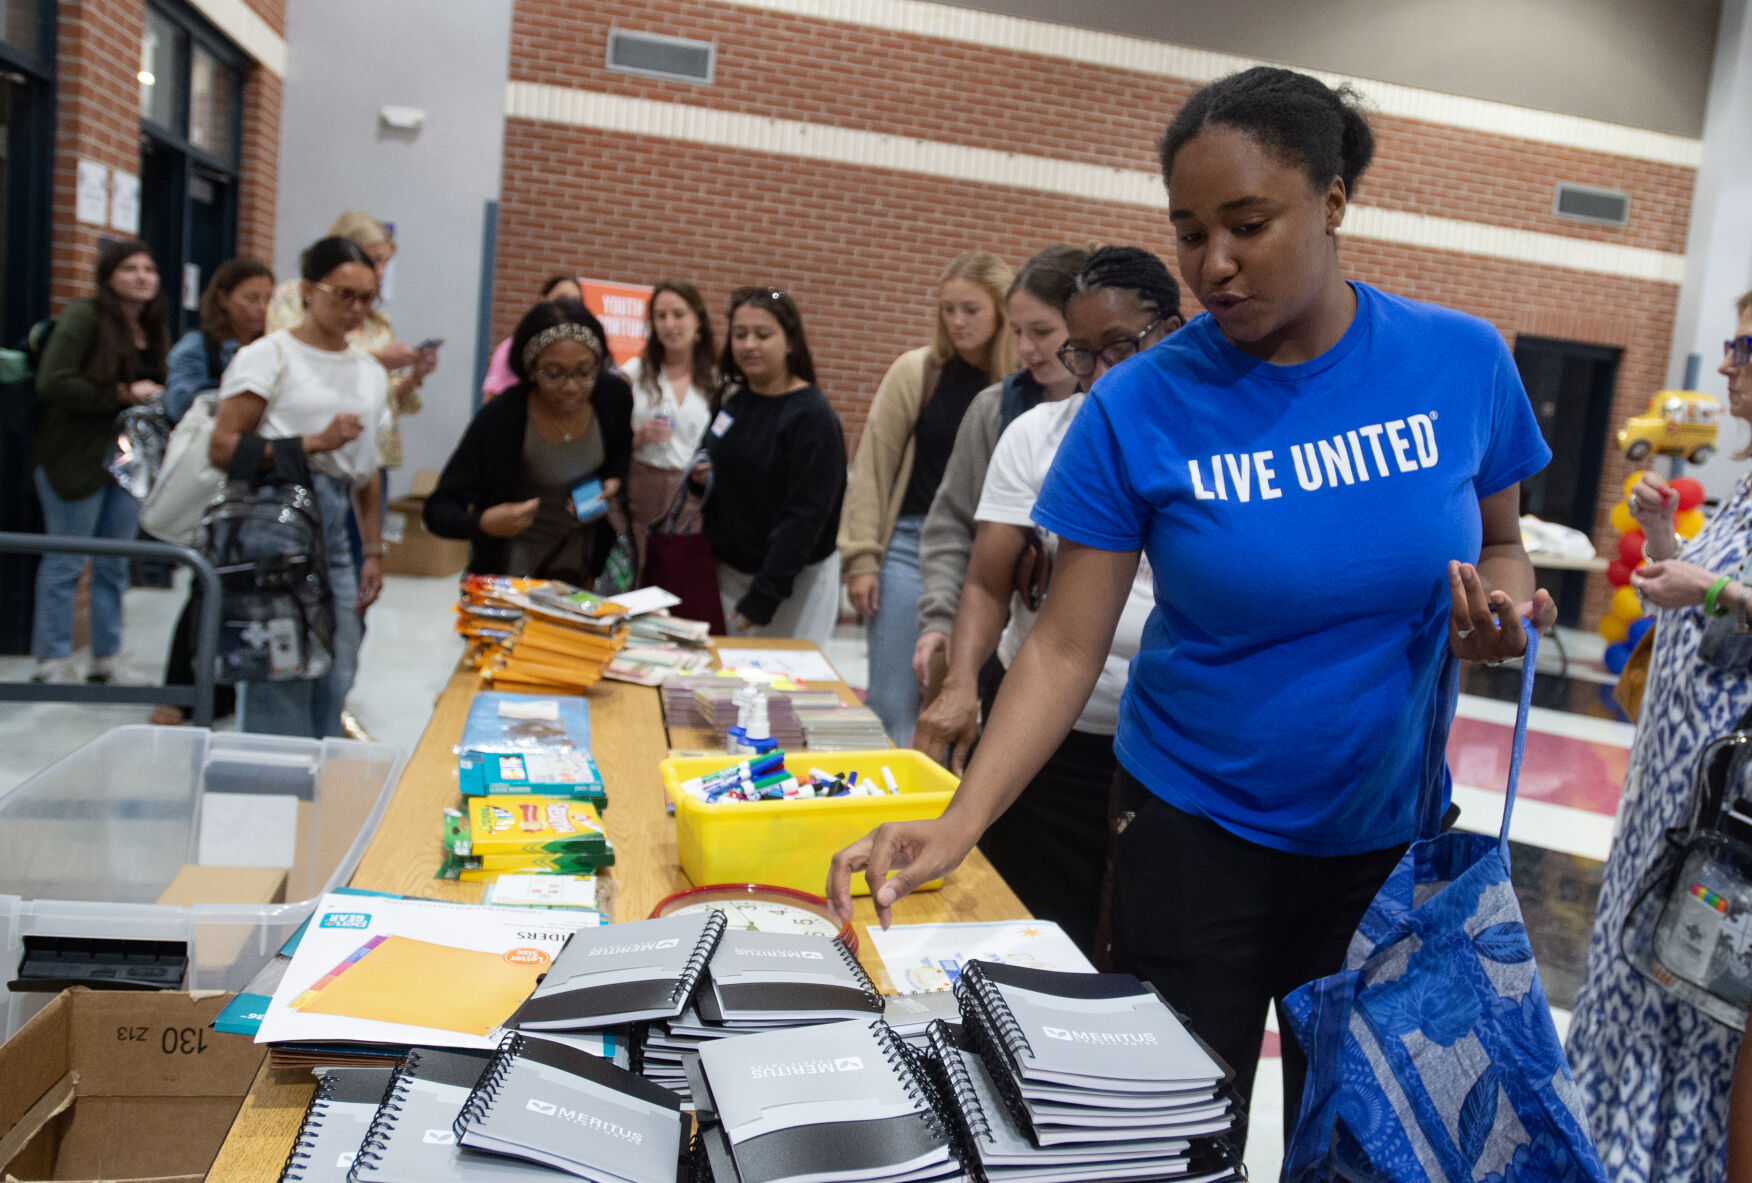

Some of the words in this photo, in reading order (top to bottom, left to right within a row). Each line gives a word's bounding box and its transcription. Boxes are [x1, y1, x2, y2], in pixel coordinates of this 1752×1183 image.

[602, 294, 645, 317] YOUTH
[1188, 450, 1283, 502] LIVE
[329, 914, 365, 922] GEAR
[516, 931, 566, 941] IDERS
[587, 943, 656, 957] MERITUS
[735, 949, 801, 959] MERITUS
[510, 955, 543, 963] Letter
[117, 1026, 149, 1042] Z13
[161, 1027, 208, 1055] 130
[1071, 1030, 1157, 1043] MERITUS
[750, 1063, 835, 1079] MERITUS
[558, 1106, 644, 1143] MERITUS
